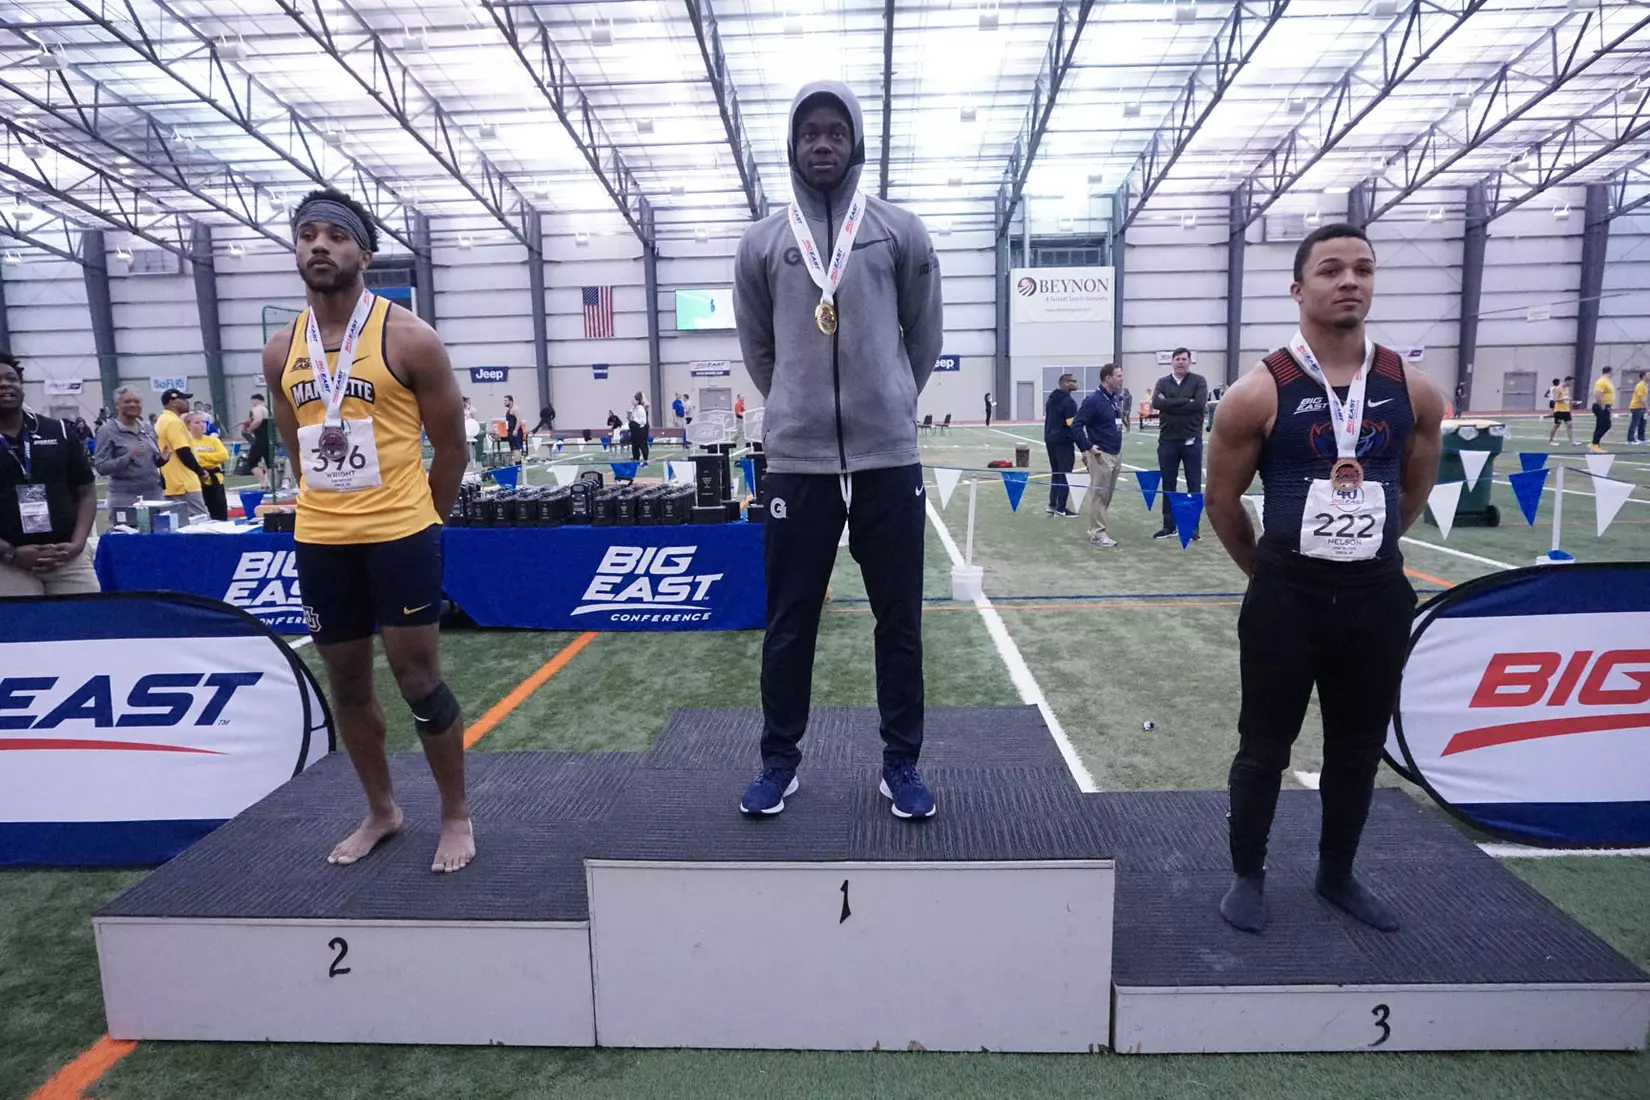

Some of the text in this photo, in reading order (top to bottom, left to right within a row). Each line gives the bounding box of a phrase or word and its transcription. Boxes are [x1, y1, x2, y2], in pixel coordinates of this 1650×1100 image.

[810, 251, 820, 270] EAST
[1040, 278, 1109, 293] BEYNON
[349, 320, 358, 339] EAST
[476, 369, 503, 380] Jeep
[935, 359, 954, 369] eep
[321, 373, 331, 393] EAST
[770, 497, 787, 518] G
[1314, 513, 1376, 538] 222
[596, 546, 697, 574] BIG
[223, 580, 302, 606] EA
[582, 573, 724, 602] EAST
[610, 612, 712, 622] CONFERENCE
[1468, 649, 1650, 708] BIG
[0, 672, 264, 730] EAST
[840, 879, 851, 924] 1
[328, 936, 351, 978] 2
[1368, 1004, 1390, 1047] 3
